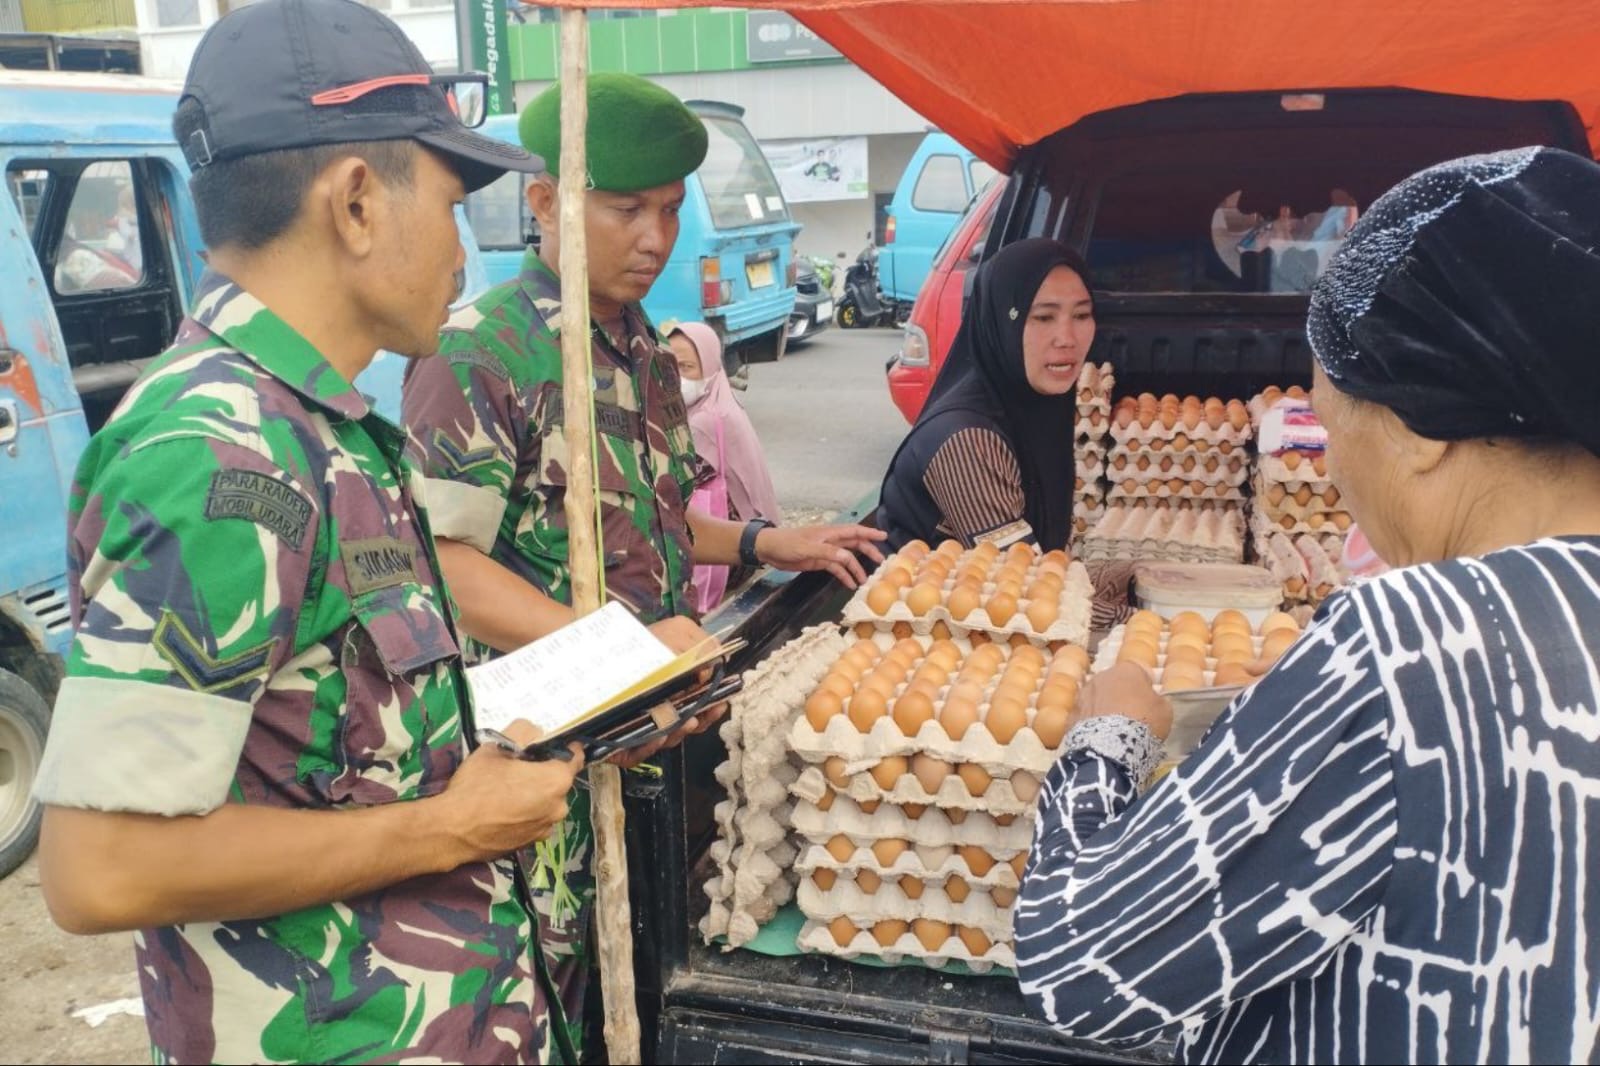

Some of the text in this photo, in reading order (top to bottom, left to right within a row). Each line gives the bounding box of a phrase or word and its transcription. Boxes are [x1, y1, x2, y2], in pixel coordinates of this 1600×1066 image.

[482, 0, 499, 87] Pegadai
[211, 498, 299, 541] MOBIL UDARA
[219, 474, 308, 520] PARA RAIDER
